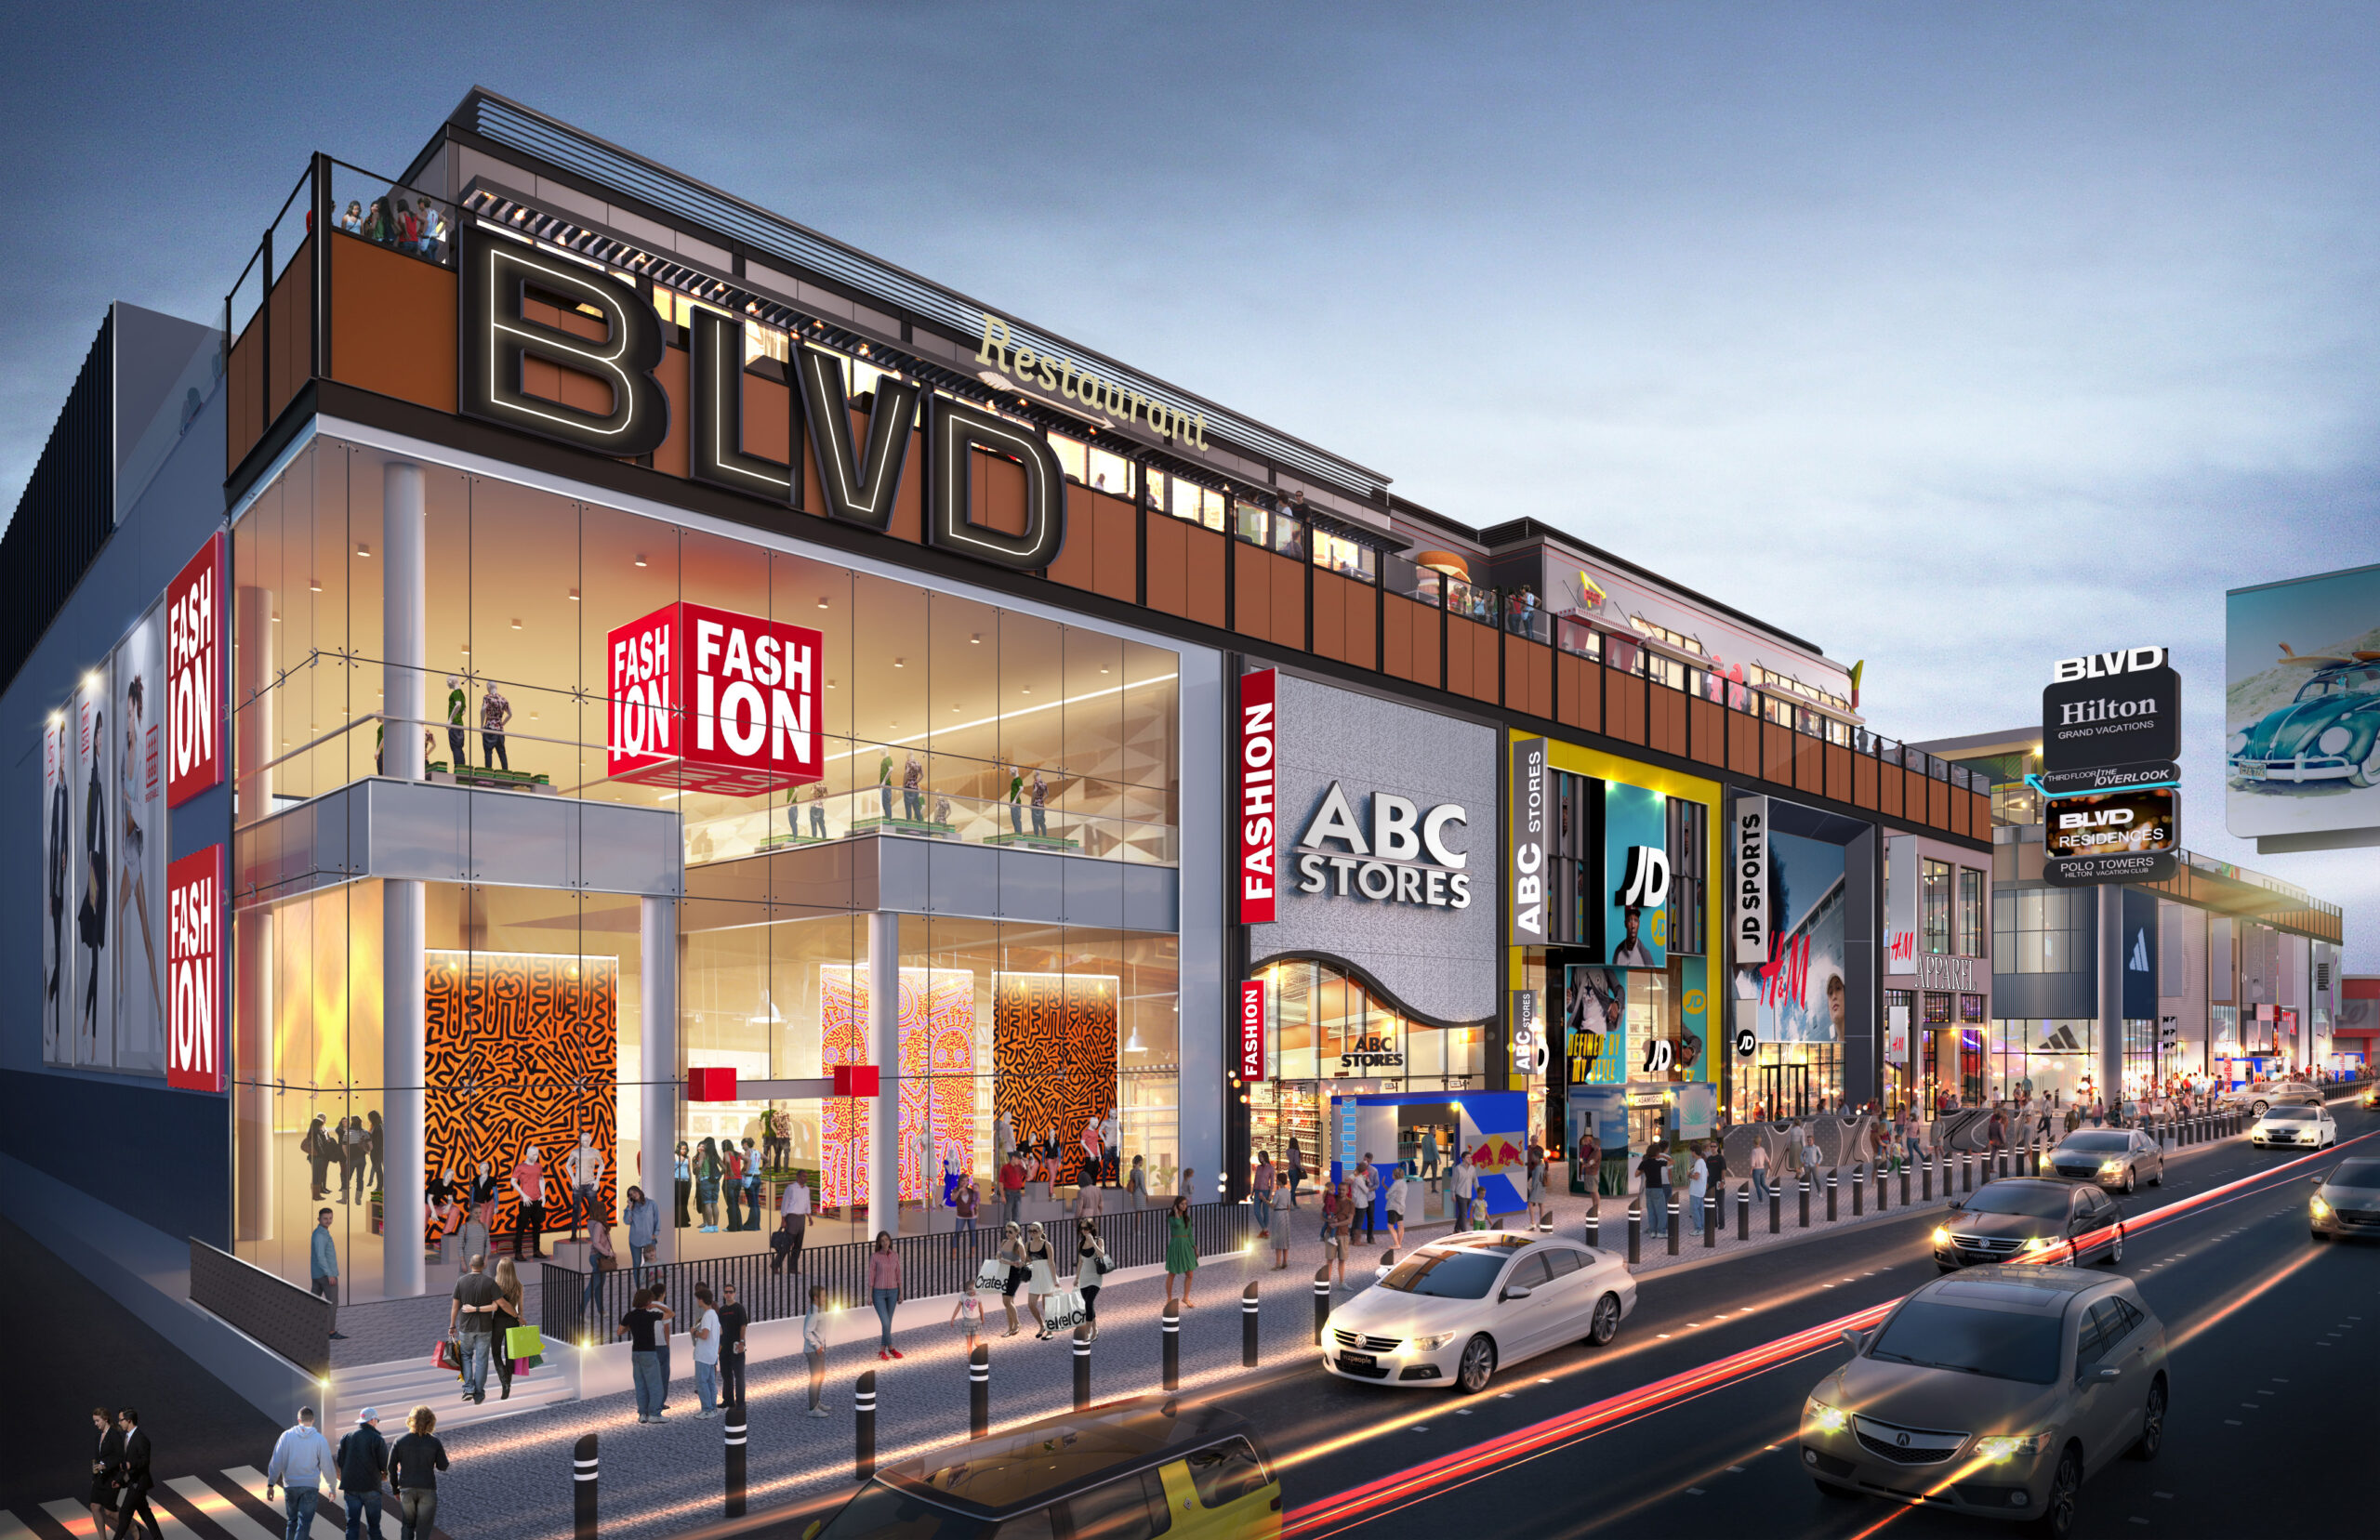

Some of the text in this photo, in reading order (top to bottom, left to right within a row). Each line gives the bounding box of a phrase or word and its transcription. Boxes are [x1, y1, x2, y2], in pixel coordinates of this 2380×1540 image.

[459, 219, 1067, 571] BLVD
[974, 313, 1210, 452] Restaurant
[170, 566, 211, 678] FASH
[615, 624, 669, 691] FASH
[697, 618, 812, 694] FASH
[2055, 645, 2163, 684] BLVD
[169, 646, 212, 784] ION
[614, 675, 669, 761] ION
[697, 673, 812, 765] ION
[2057, 720, 2154, 740] GRAND VACATIONS
[2060, 698, 2158, 725] Hilton
[2047, 770, 2096, 782] THIRD FLOOR
[2097, 770, 2169, 785] OVERLOOK
[2101, 768, 2117, 776] THE
[1245, 701, 1274, 902] FASHION
[2059, 808, 2135, 829] BLVD
[1301, 779, 1469, 871] ABC
[1516, 750, 1541, 935] ABC STORES
[2059, 827, 2164, 848] RESIDENCES
[1299, 854, 1472, 910] STORES
[1620, 846, 1671, 908] JD
[1741, 813, 1761, 946] JD SPORTS
[2060, 857, 2154, 873] POLO TOWERS
[2065, 870, 2093, 878] HILTON
[2096, 867, 2130, 876] VACATION
[171, 876, 212, 960] FASH
[1890, 931, 1914, 962] H&M
[1759, 929, 1811, 1011] H&M
[1914, 954, 1977, 992] APPAREL
[2317, 963, 2329, 992] PUMA
[170, 956, 212, 1074] ION
[1686, 994, 1704, 1008] JD
[1244, 989, 1259, 1077] FASHION
[1353, 1036, 1393, 1053] ABC
[1515, 1031, 1530, 1070] ABC
[1567, 1033, 1620, 1056] DEFINED BY
[1739, 1035, 1754, 1050] JD
[1892, 1036, 1904, 1053] H&M
[1342, 1052, 1404, 1068] STORES
[1572, 1059, 1616, 1082] MY STYLE
[1646, 1040, 1672, 1072] JD
[1341, 1099, 1356, 1171] drink
[1342, 1353, 1373, 1365] vizpeople
